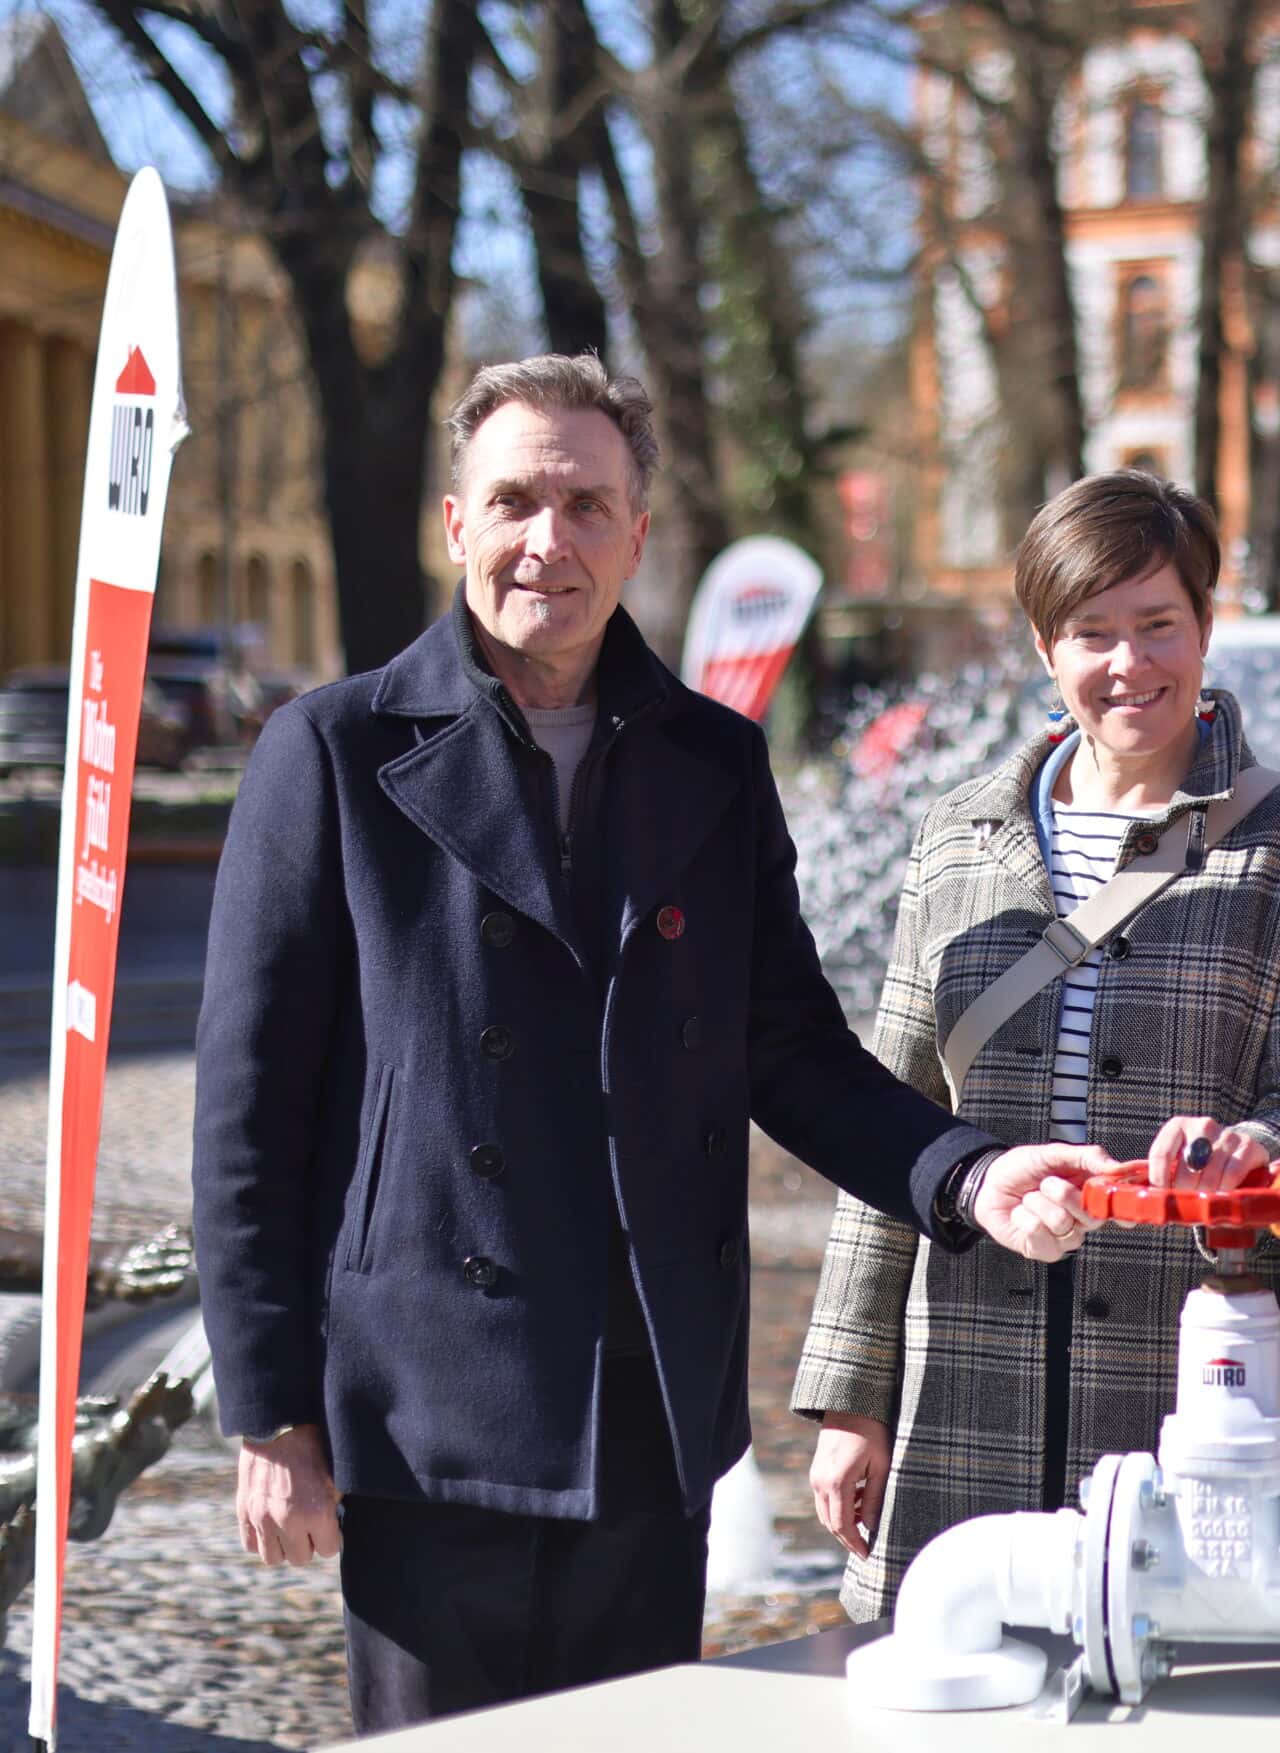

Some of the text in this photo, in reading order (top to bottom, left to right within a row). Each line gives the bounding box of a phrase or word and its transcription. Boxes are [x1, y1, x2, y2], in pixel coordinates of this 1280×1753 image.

[108, 406, 154, 516] WIRO
[81, 698, 116, 774] Wohn
[1202, 1367, 1246, 1387] WIRO
